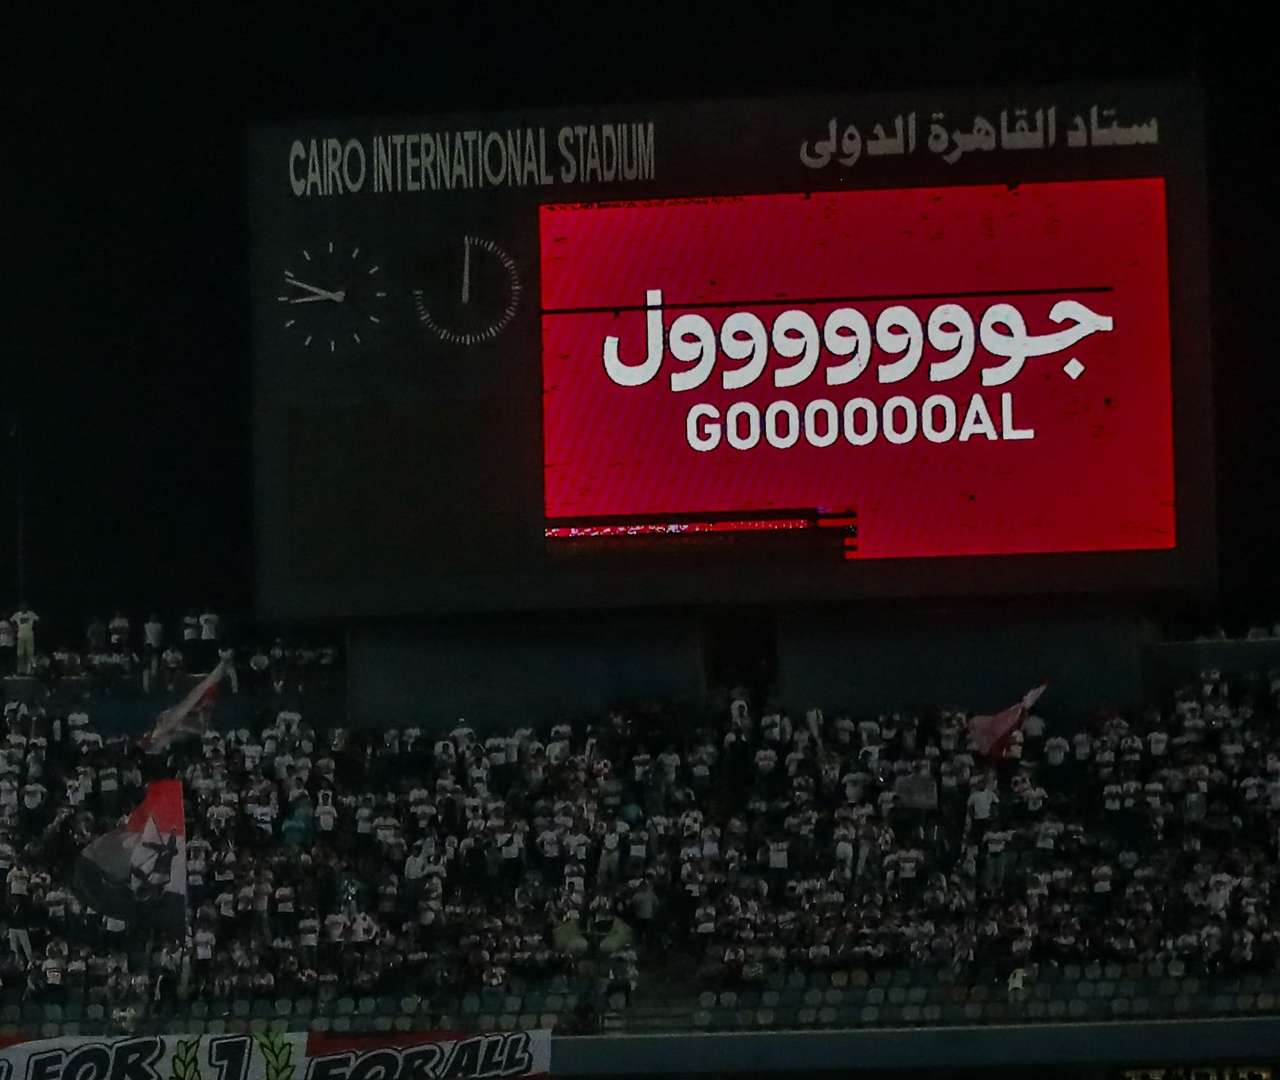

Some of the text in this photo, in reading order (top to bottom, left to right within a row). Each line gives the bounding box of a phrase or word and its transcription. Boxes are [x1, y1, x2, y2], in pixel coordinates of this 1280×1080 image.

[928, 105, 1056, 166] القاهرة
[1067, 105, 1159, 147] ستاد
[290, 121, 655, 197] CAIRO INTERNATIONAL STADIUM
[602, 288, 1114, 393] جووووووول
[686, 392, 1035, 452] GOOOOOOAL
[438, 1032, 532, 1080] ALL
